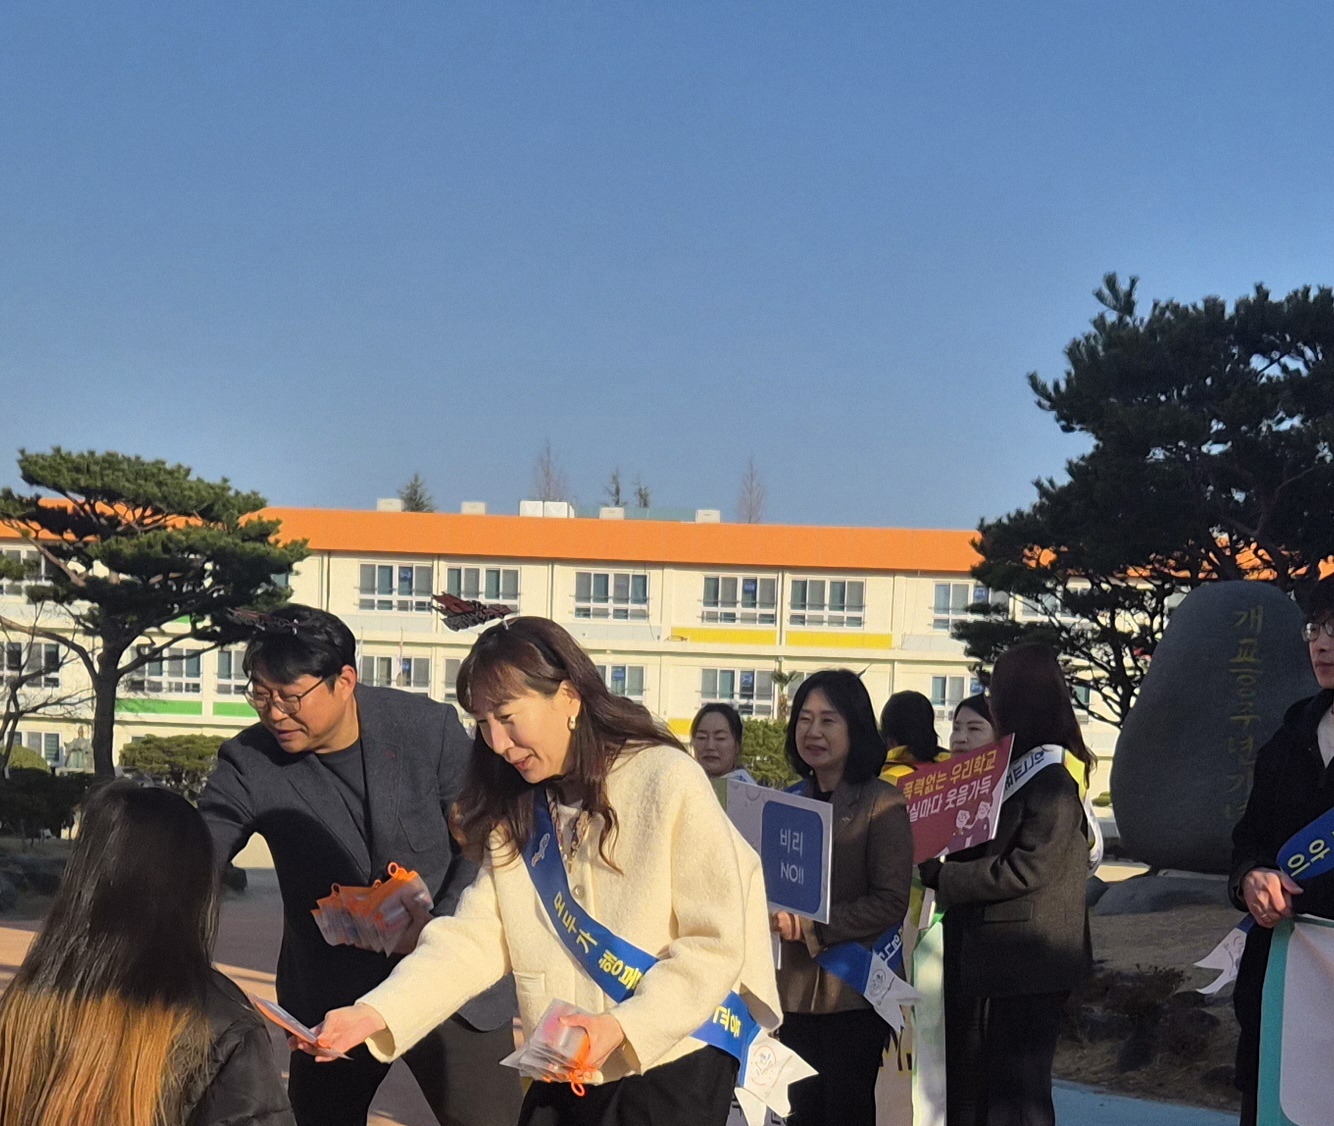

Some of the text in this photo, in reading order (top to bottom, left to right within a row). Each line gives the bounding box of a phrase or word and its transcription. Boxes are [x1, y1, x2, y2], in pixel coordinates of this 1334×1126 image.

[950, 749, 998, 784] 우리학교
[906, 774, 993, 823] 실마다 웃음가득
[780, 828, 804, 857] 비리
[780, 862, 804, 885] NO!!
[553, 891, 598, 954] 모두가
